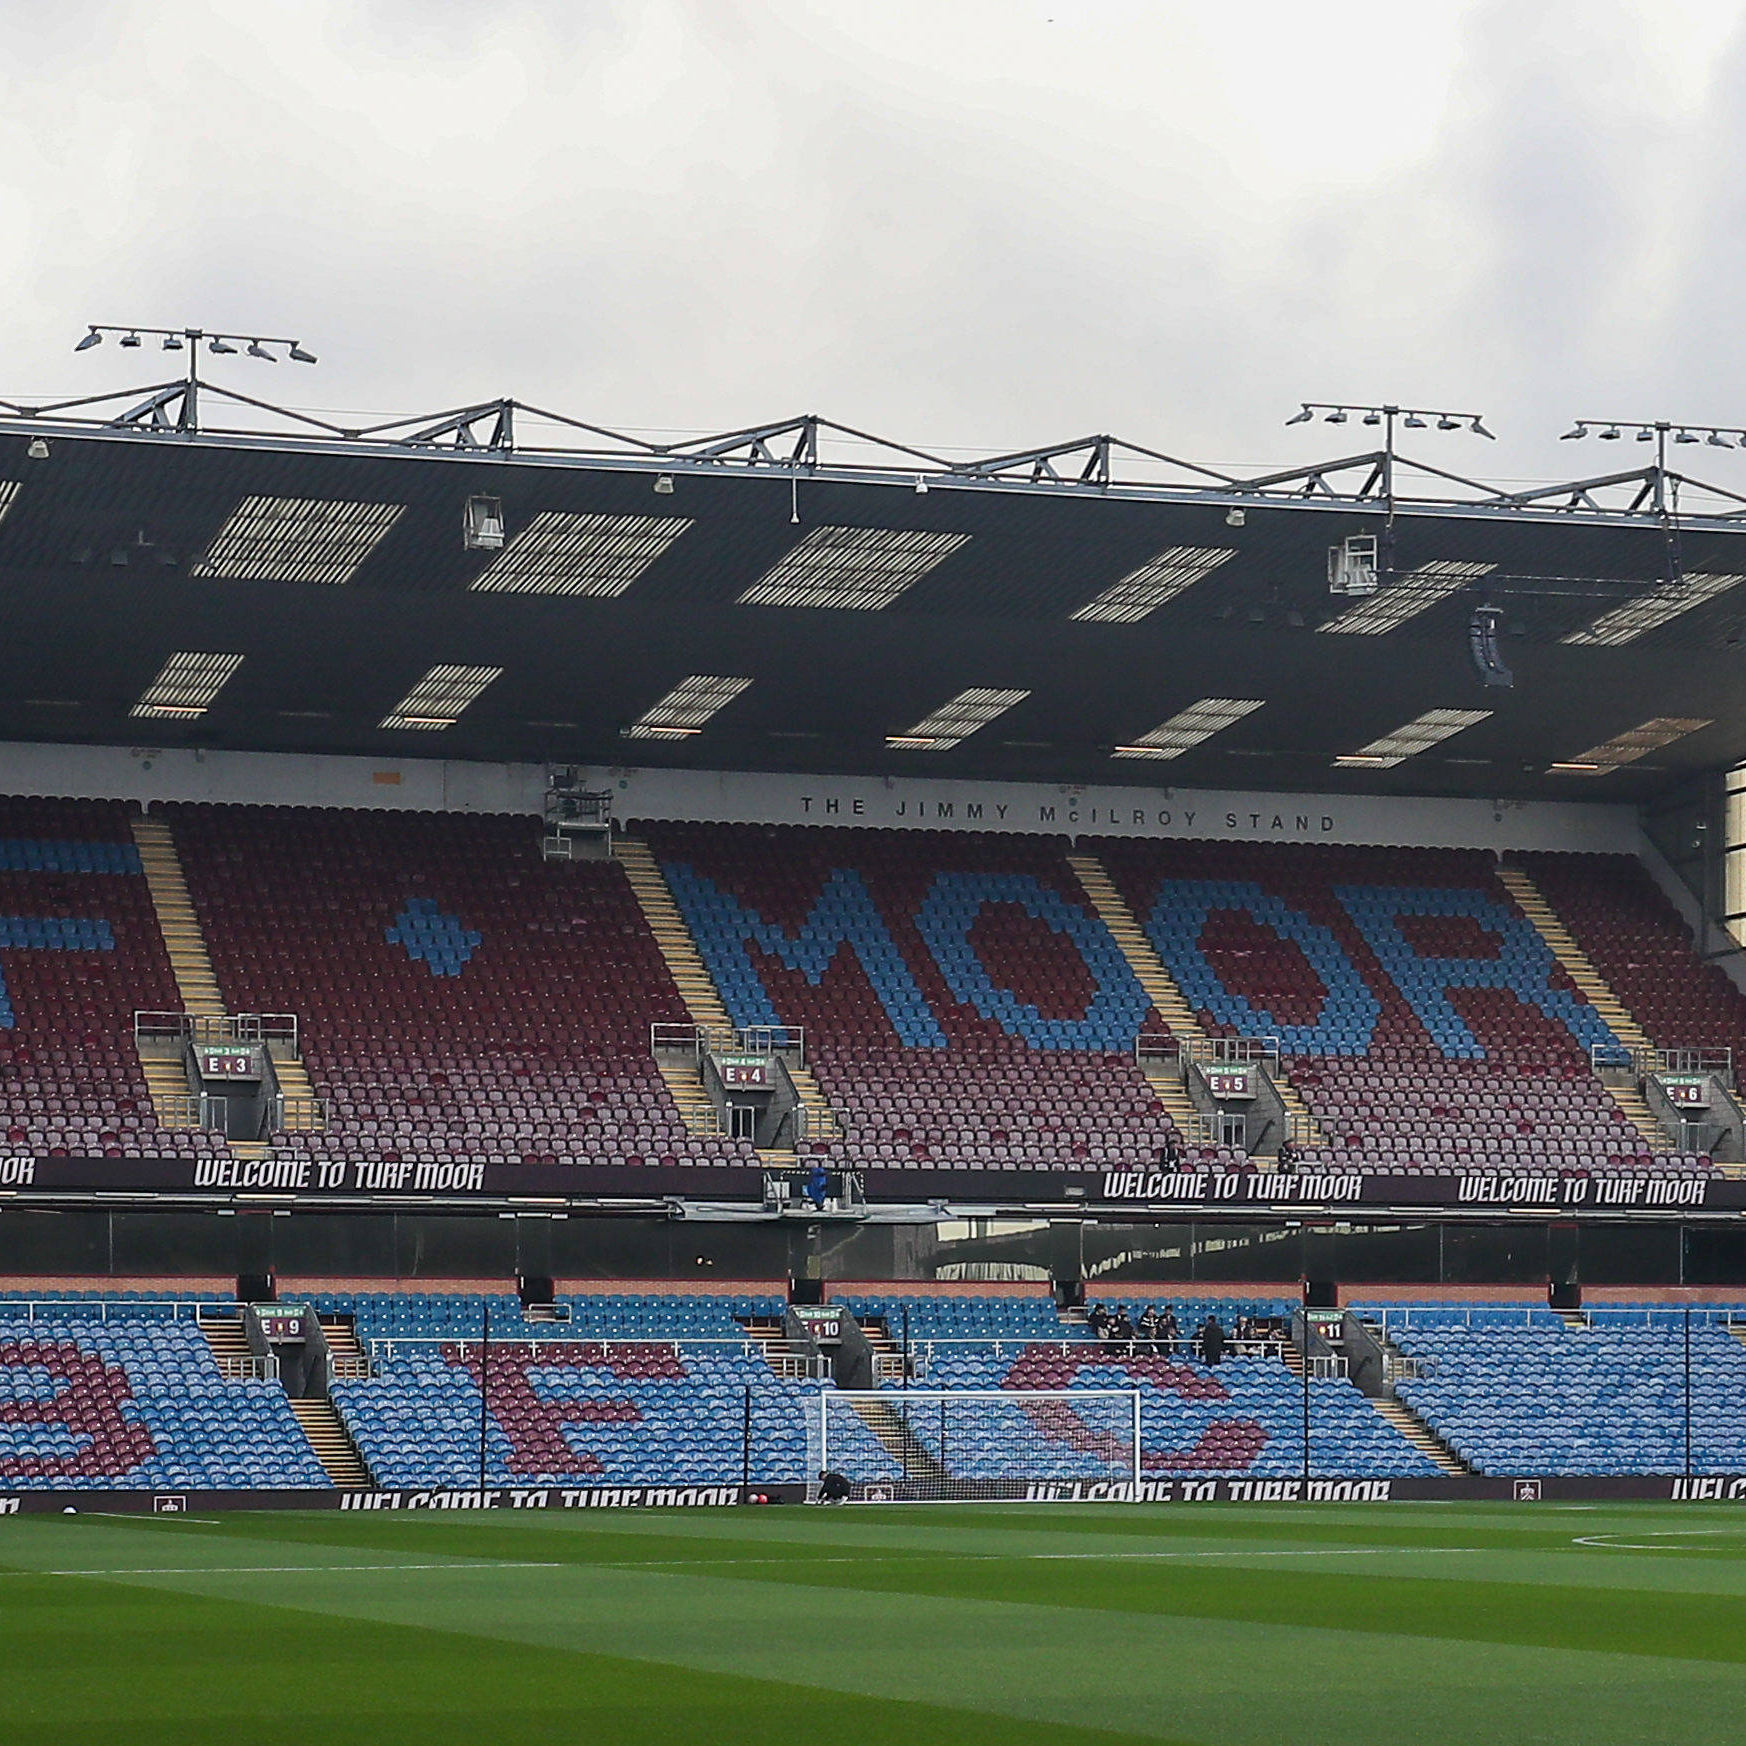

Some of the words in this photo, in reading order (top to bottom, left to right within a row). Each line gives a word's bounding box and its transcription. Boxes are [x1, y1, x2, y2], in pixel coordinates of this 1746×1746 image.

[801, 797, 864, 815] THE
[896, 801, 1008, 819] JIMMY
[1226, 812, 1334, 832] STAND
[209, 1057, 219, 1072] E
[236, 1058, 246, 1072] 3
[726, 1067, 735, 1081] E
[751, 1068, 760, 1082] 4
[1210, 1076, 1219, 1090] E
[1234, 1077, 1243, 1090] 5
[1689, 1087, 1697, 1100] 6
[194, 1160, 310, 1188] WELCOME
[317, 1161, 346, 1188] TO
[355, 1162, 413, 1189] TURF
[413, 1163, 484, 1190] MOOR
[1104, 1172, 1208, 1198] WELCOME
[1213, 1173, 1240, 1199] TO
[1246, 1174, 1299, 1199] TURF
[1299, 1175, 1363, 1200] MOOR
[1458, 1177, 1559, 1202] WELCOME
[1563, 1178, 1589, 1203] TO
[1595, 1178, 1645, 1203] TURF
[1645, 1180, 1706, 1204] MOOR
[261, 1319, 271, 1334] E
[289, 1319, 299, 1334] 9
[823, 1321, 839, 1336] 10
[1327, 1323, 1341, 1338] 11
